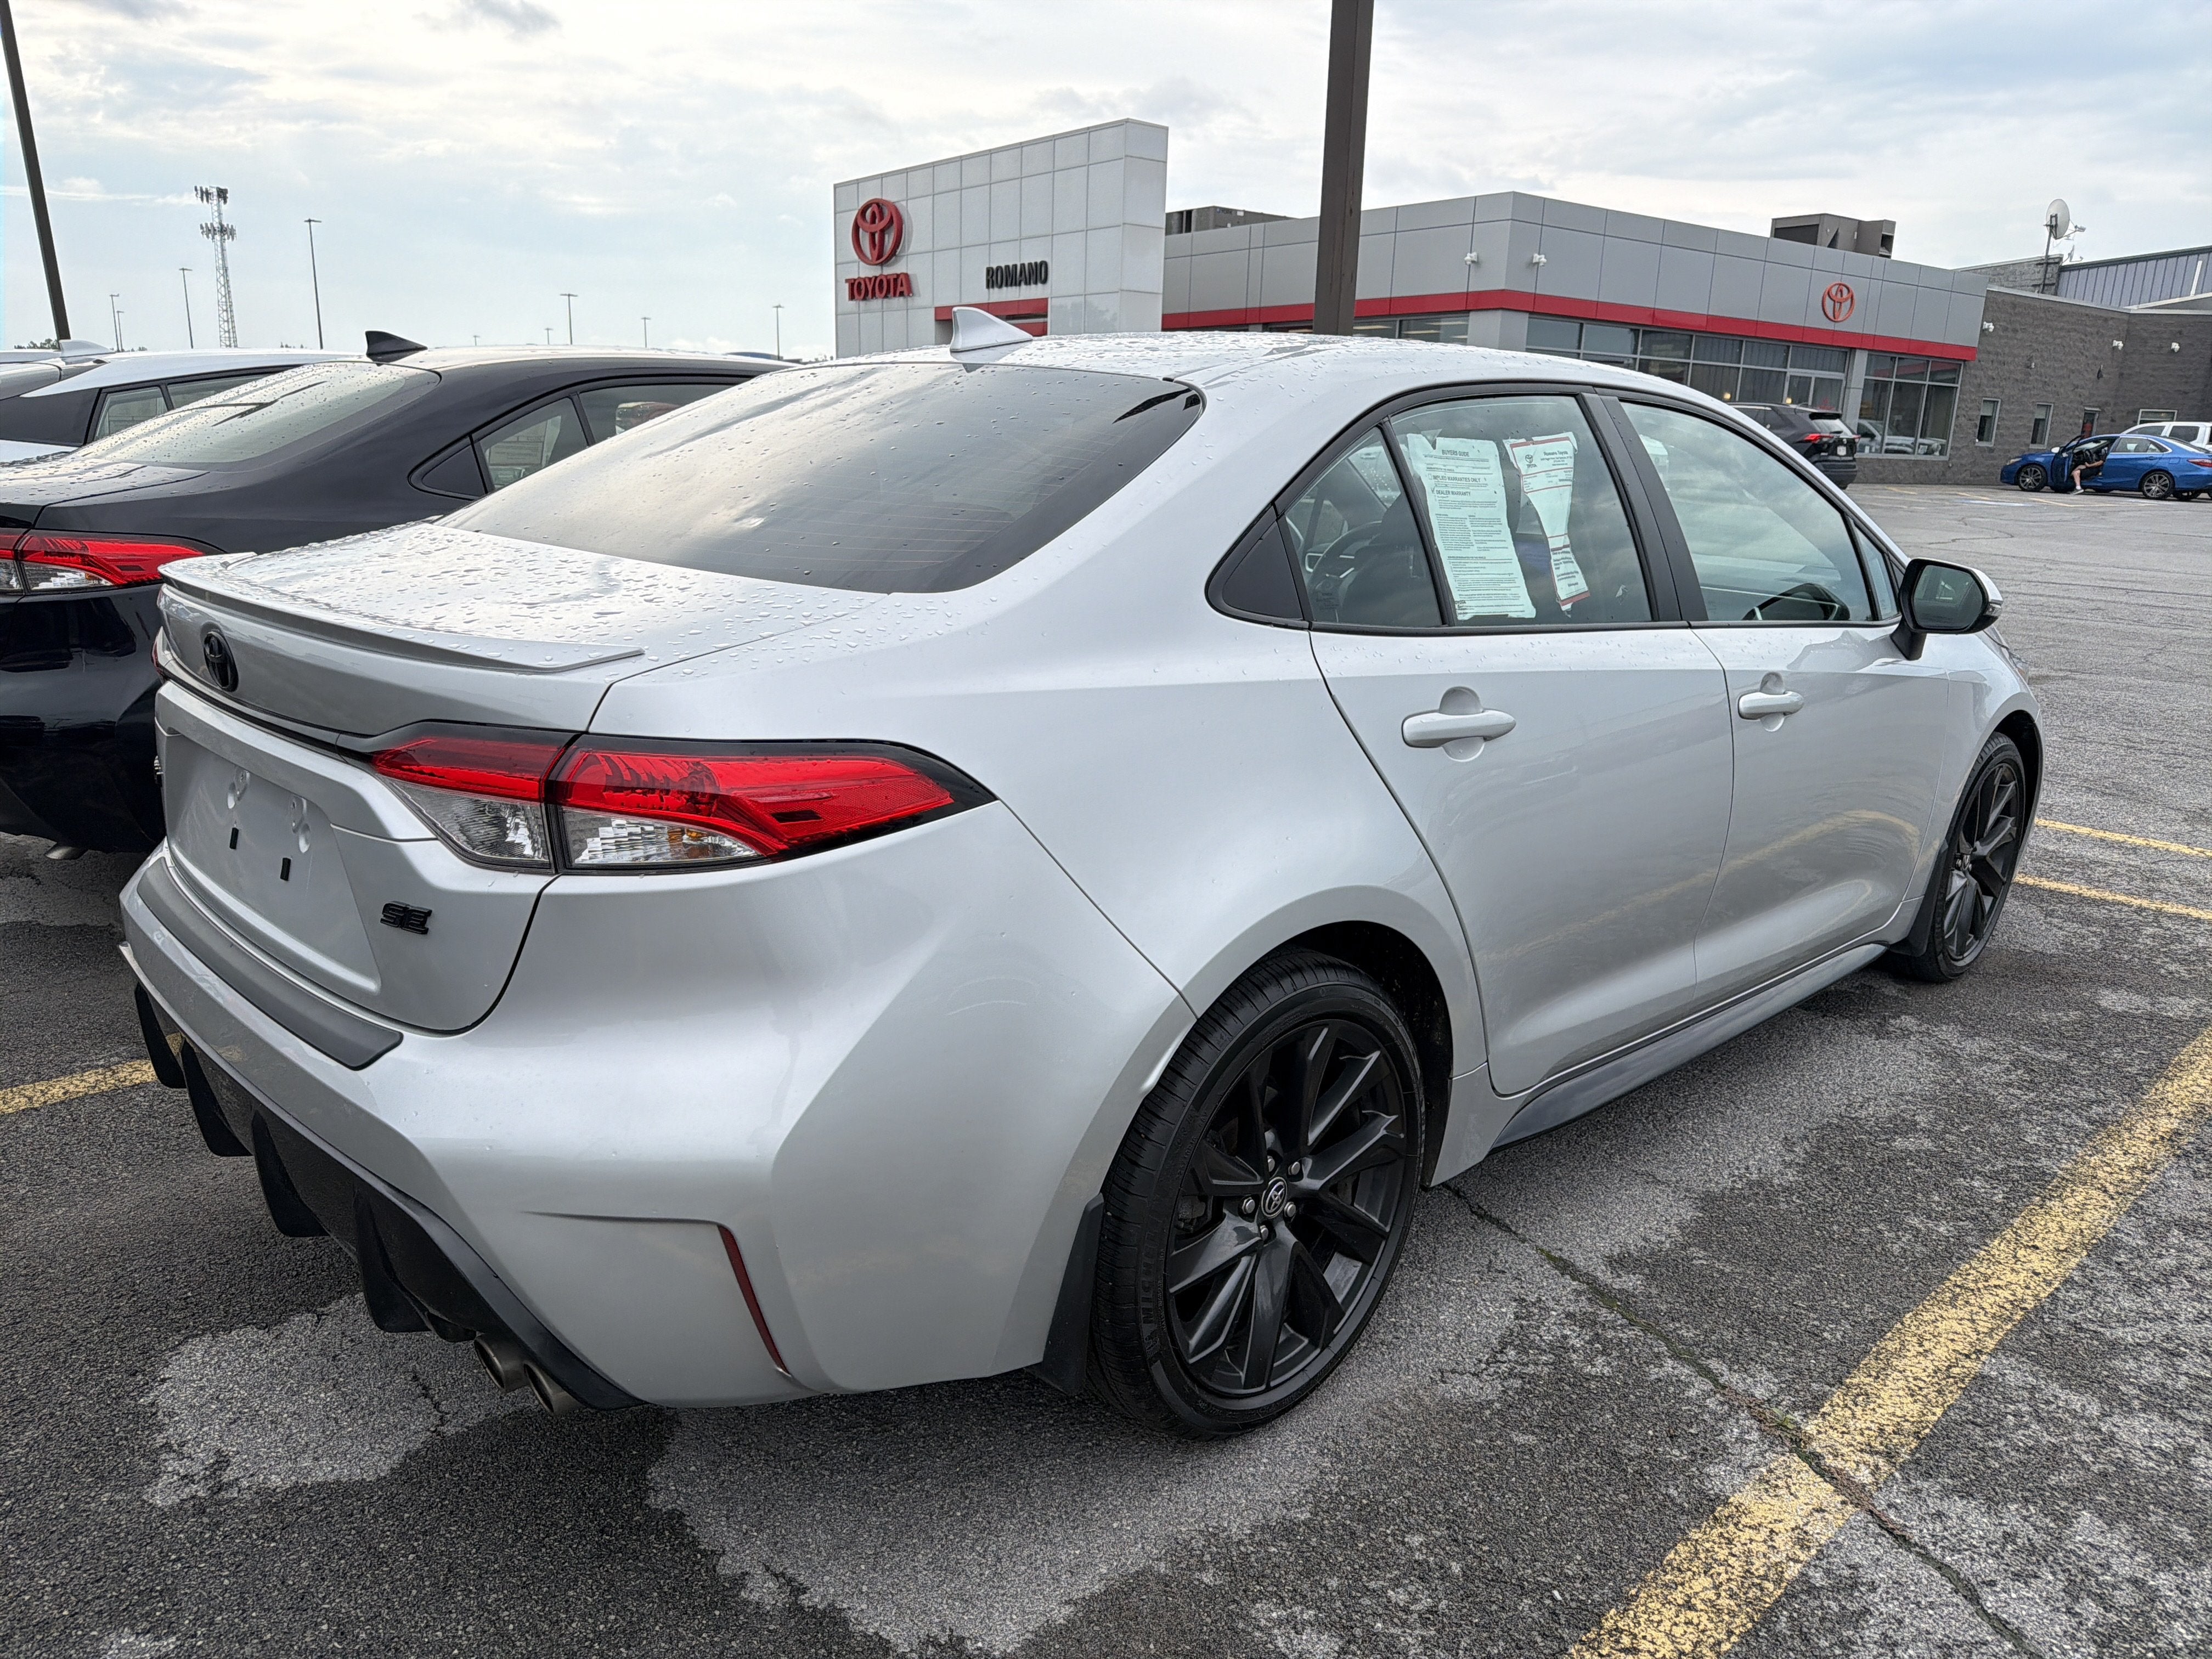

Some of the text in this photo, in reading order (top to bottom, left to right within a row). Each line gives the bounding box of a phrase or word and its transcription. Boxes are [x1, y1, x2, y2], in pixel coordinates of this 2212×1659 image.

[845, 272, 913, 301] TOYOTA
[986, 261, 1048, 289] ROMANO
[380, 901, 432, 935] SE
